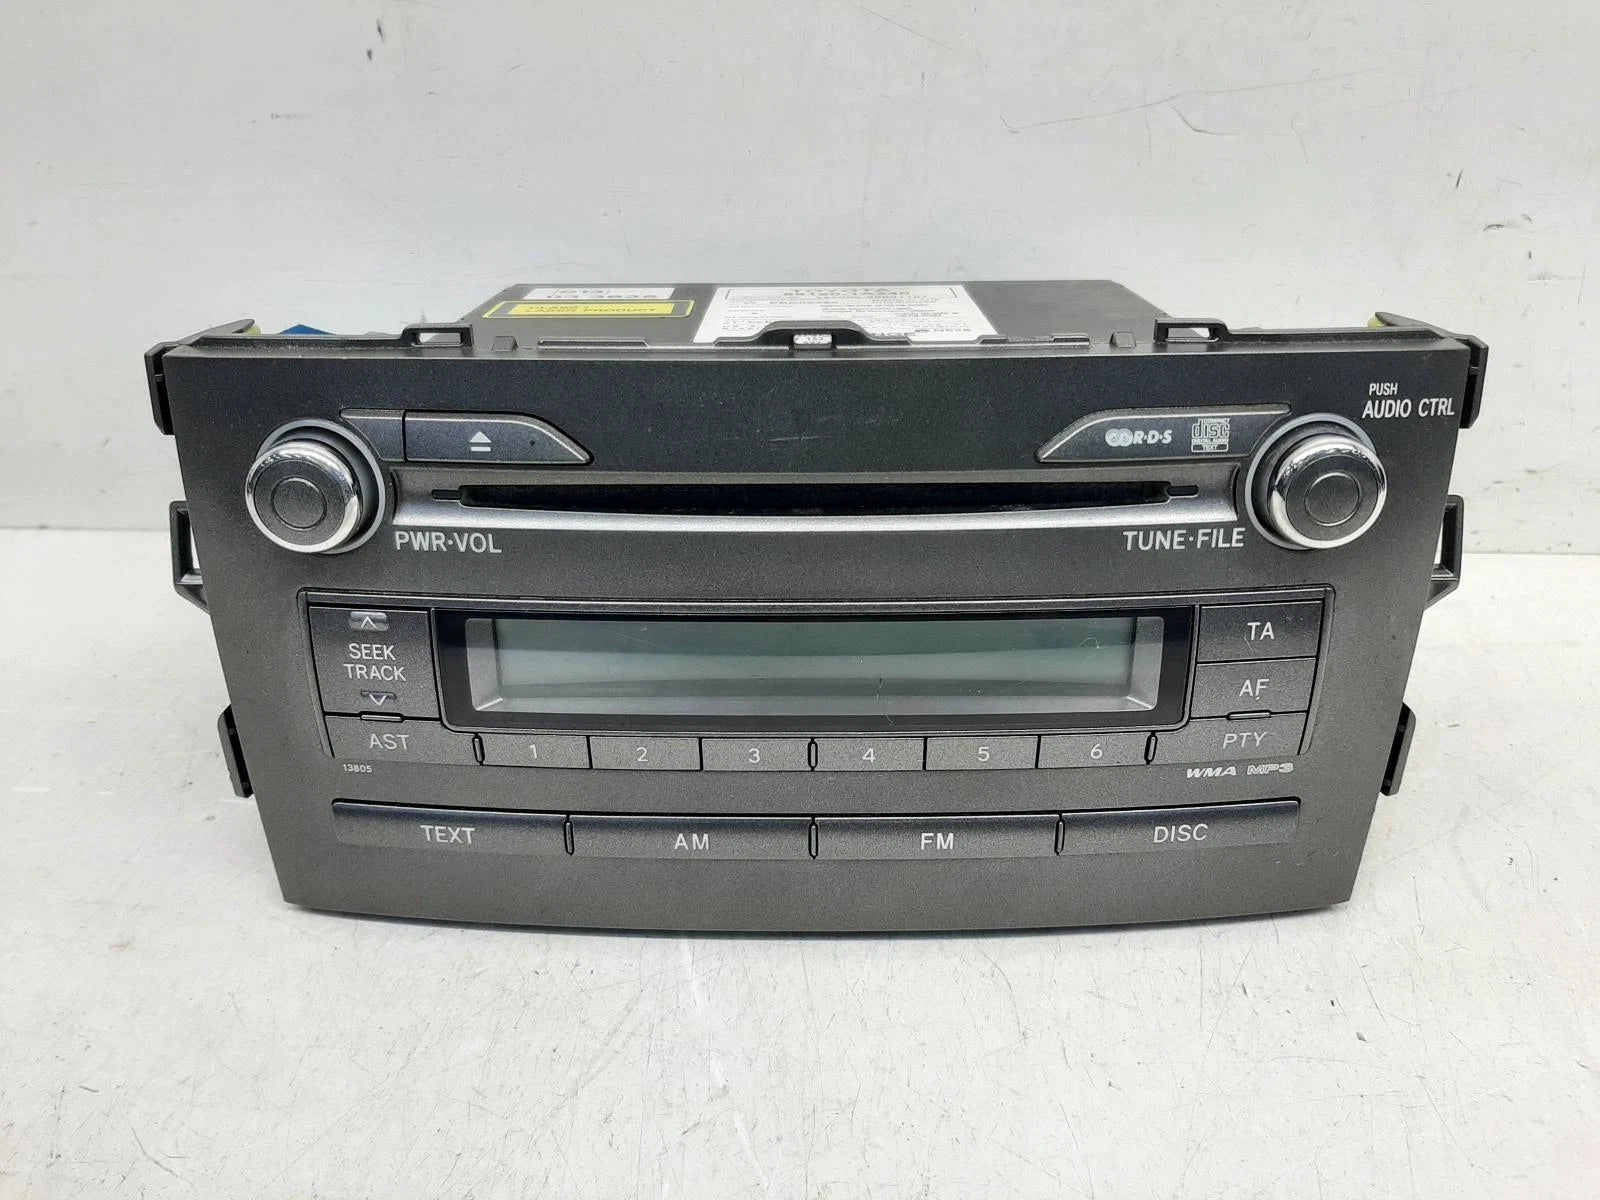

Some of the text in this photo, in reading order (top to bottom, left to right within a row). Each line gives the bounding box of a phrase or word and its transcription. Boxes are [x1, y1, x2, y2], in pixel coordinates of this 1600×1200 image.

[1368, 383, 1398, 396] PUSH
[1362, 398, 1455, 419] AUDIO CTRL
[1247, 621, 1275, 641] TA
[349, 643, 396, 661] SEEK
[344, 663, 407, 682] TRACK
[1239, 679, 1270, 697] AF
[369, 733, 410, 750] AST
[1223, 732, 1268, 749] PTY
[529, 744, 539, 759] 1
[635, 747, 649, 762] 2
[748, 748, 761, 763] 3
[862, 748, 876, 763] 4
[977, 747, 990, 762] 5
[1090, 744, 1103, 760] 6
[342, 763, 373, 774] 13805
[1186, 763, 1294, 779] WMA MP3
[420, 824, 476, 845] TEXT
[674, 833, 709, 850] AM
[920, 832, 955, 850] FM
[1153, 824, 1209, 843] DISC
